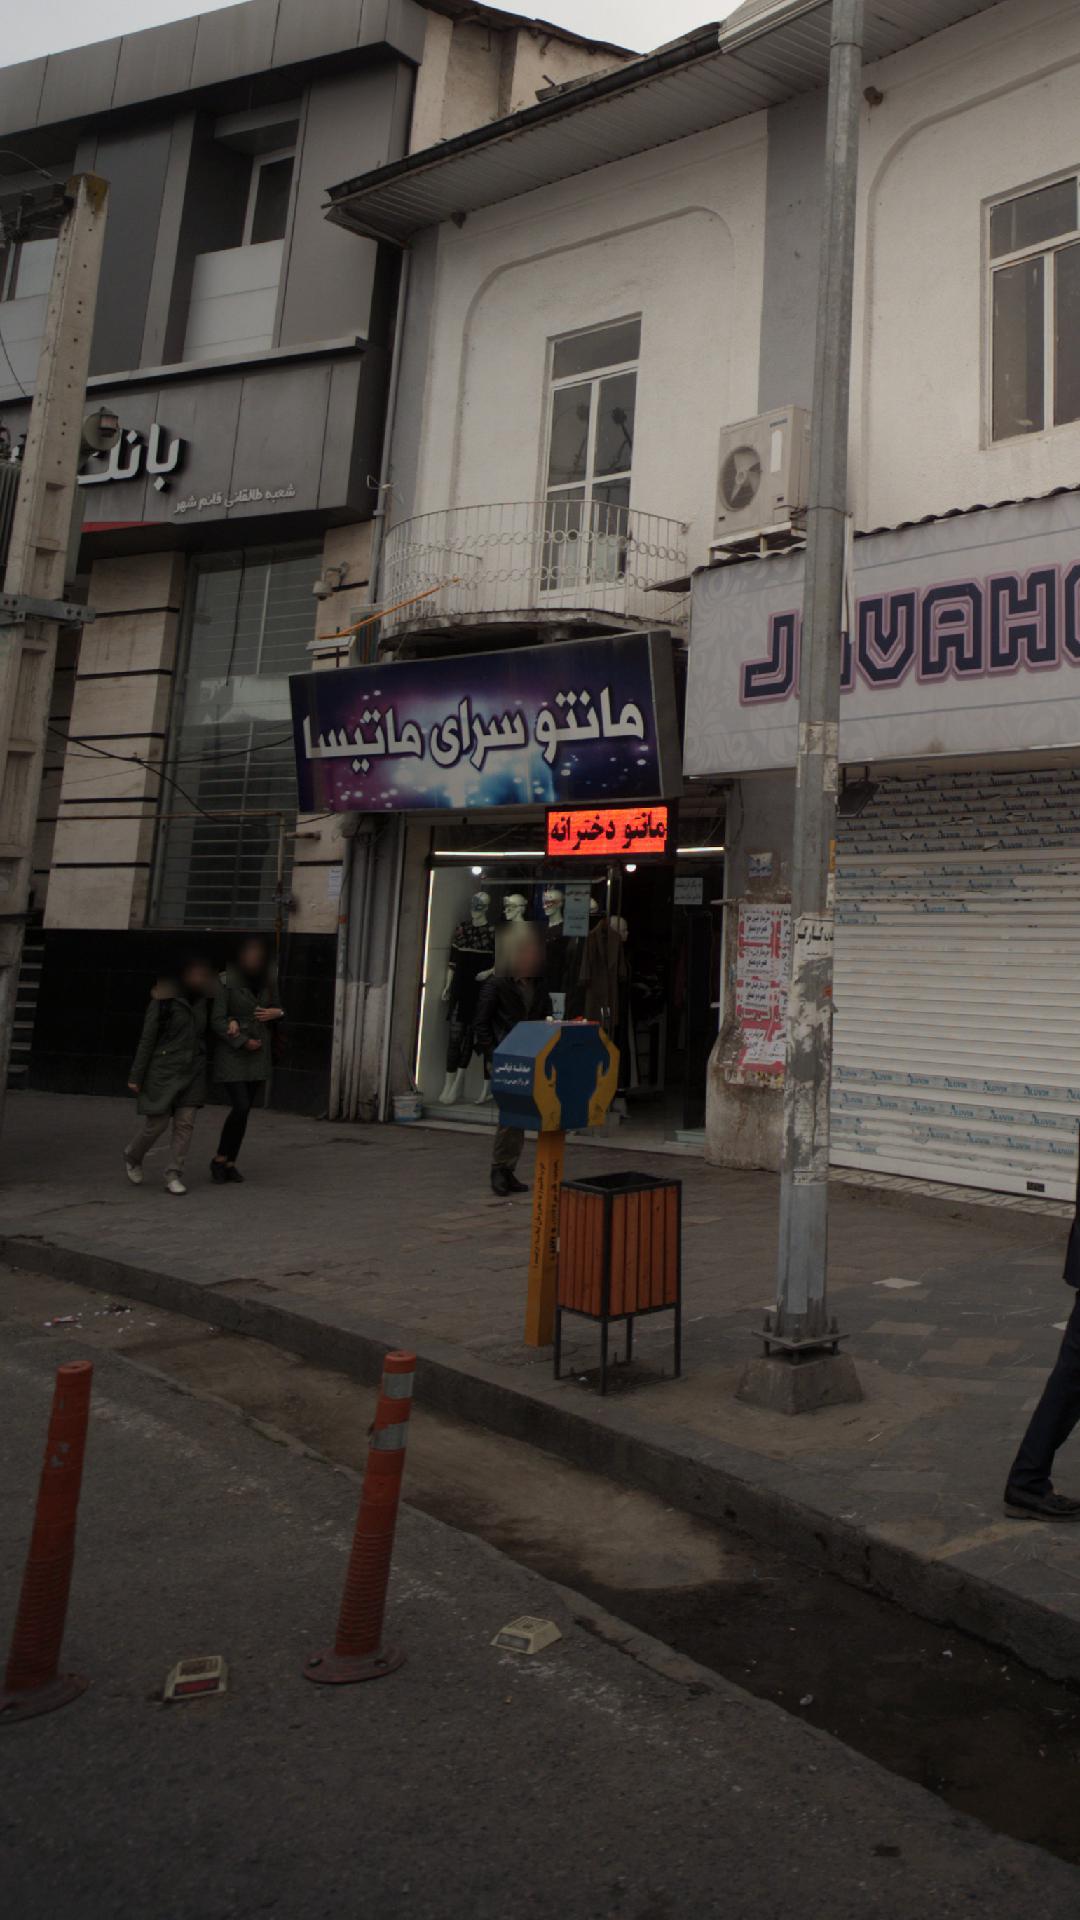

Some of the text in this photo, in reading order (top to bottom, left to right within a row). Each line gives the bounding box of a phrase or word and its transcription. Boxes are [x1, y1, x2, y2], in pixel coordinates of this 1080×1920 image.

[224, 488, 263, 508] طالقانی
[265, 483, 296, 504] شعبه
[741, 560, 1080, 704] JVAH
[302, 687, 645, 774] مانتو سرای ماتیسا
[622, 811, 666, 849] مانتو
